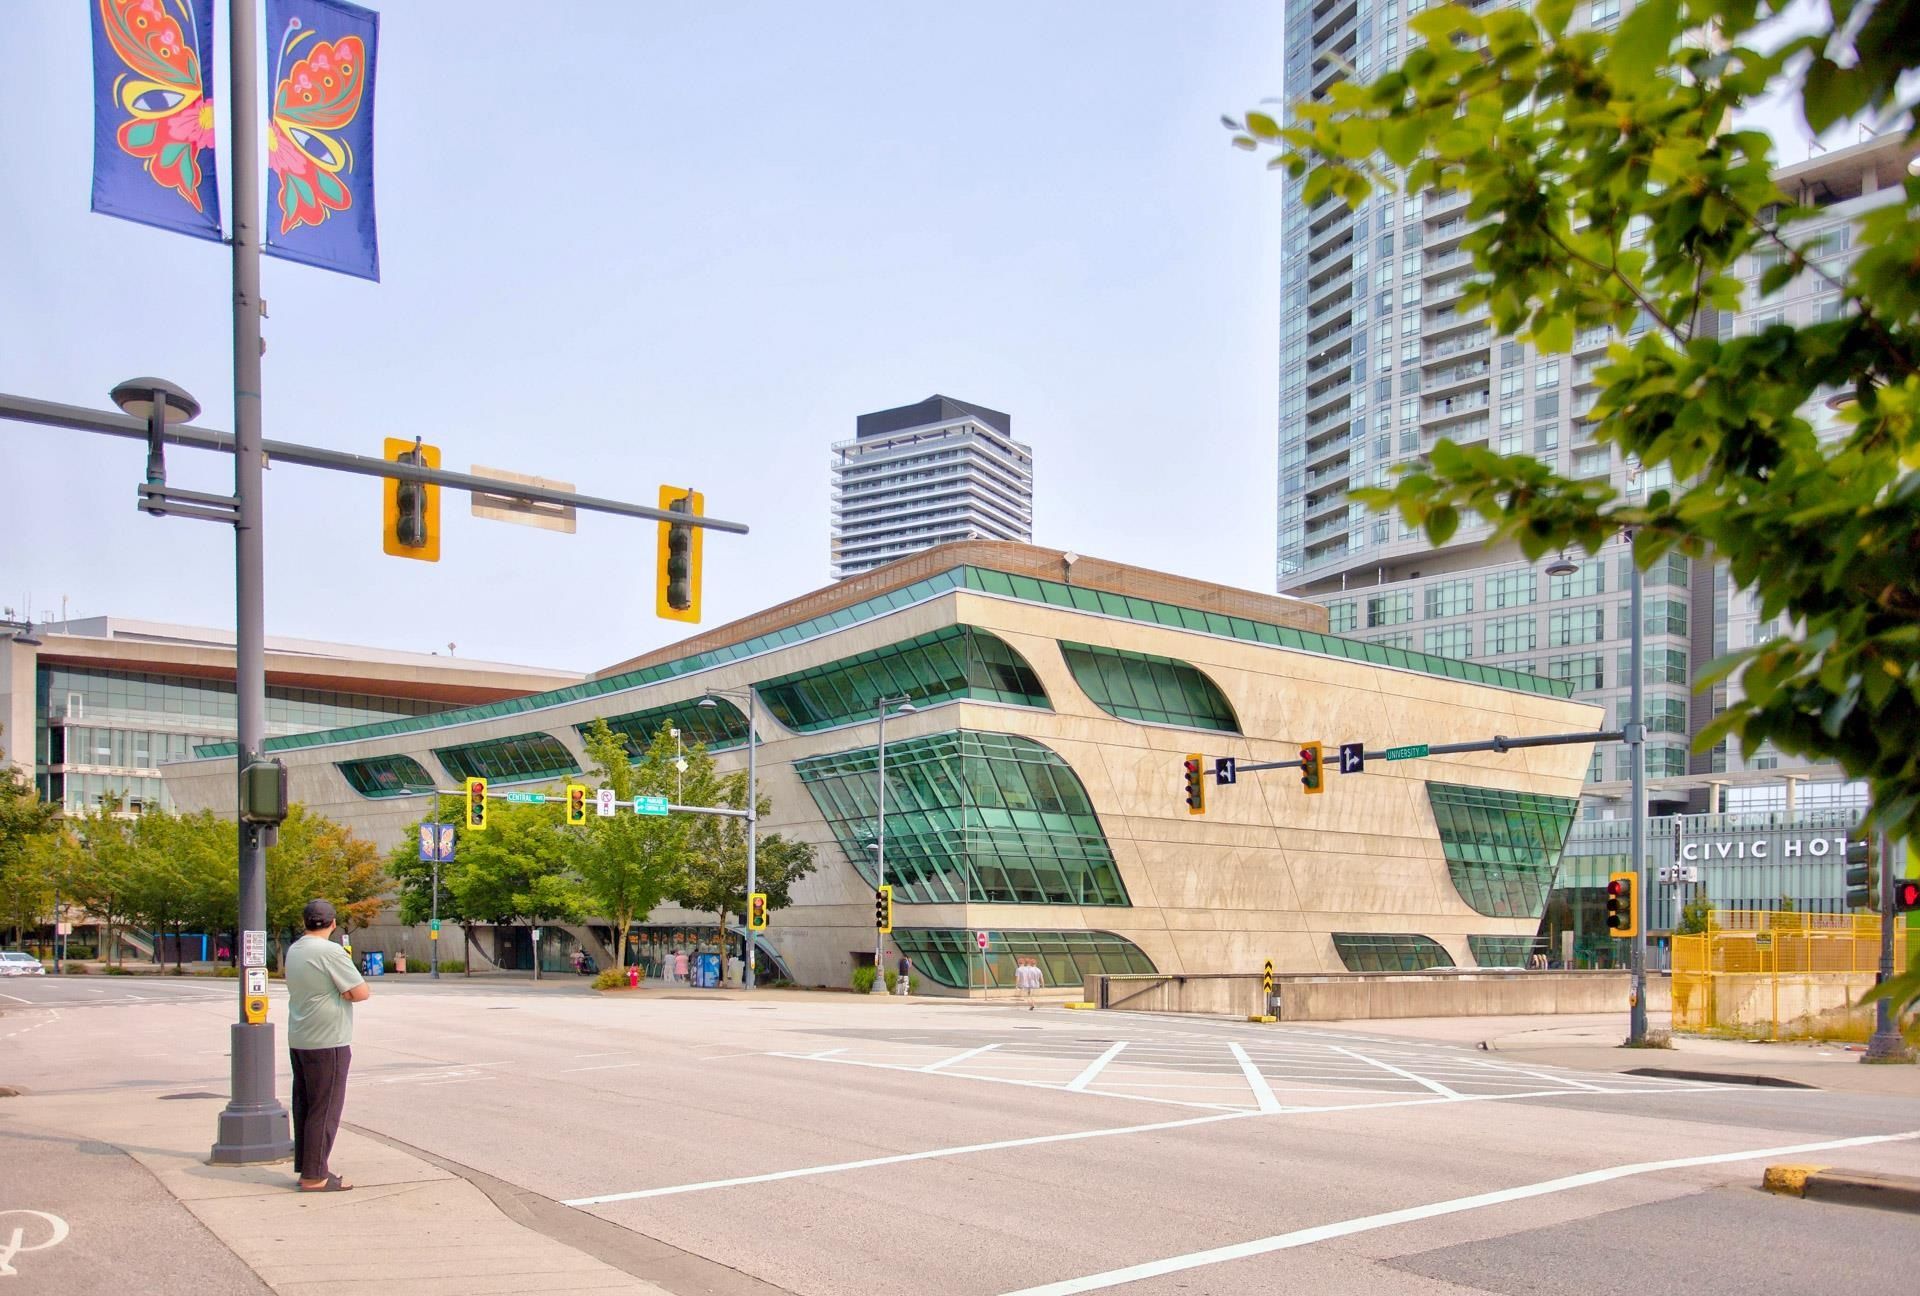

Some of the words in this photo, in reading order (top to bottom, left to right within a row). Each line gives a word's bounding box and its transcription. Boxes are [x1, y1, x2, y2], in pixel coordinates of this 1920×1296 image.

[1387, 748, 1420, 760] UNIVERSITY
[508, 793, 533, 802] CENTRAL
[1682, 840, 1768, 861] CIVIC
[1784, 837, 1867, 859] HOT
